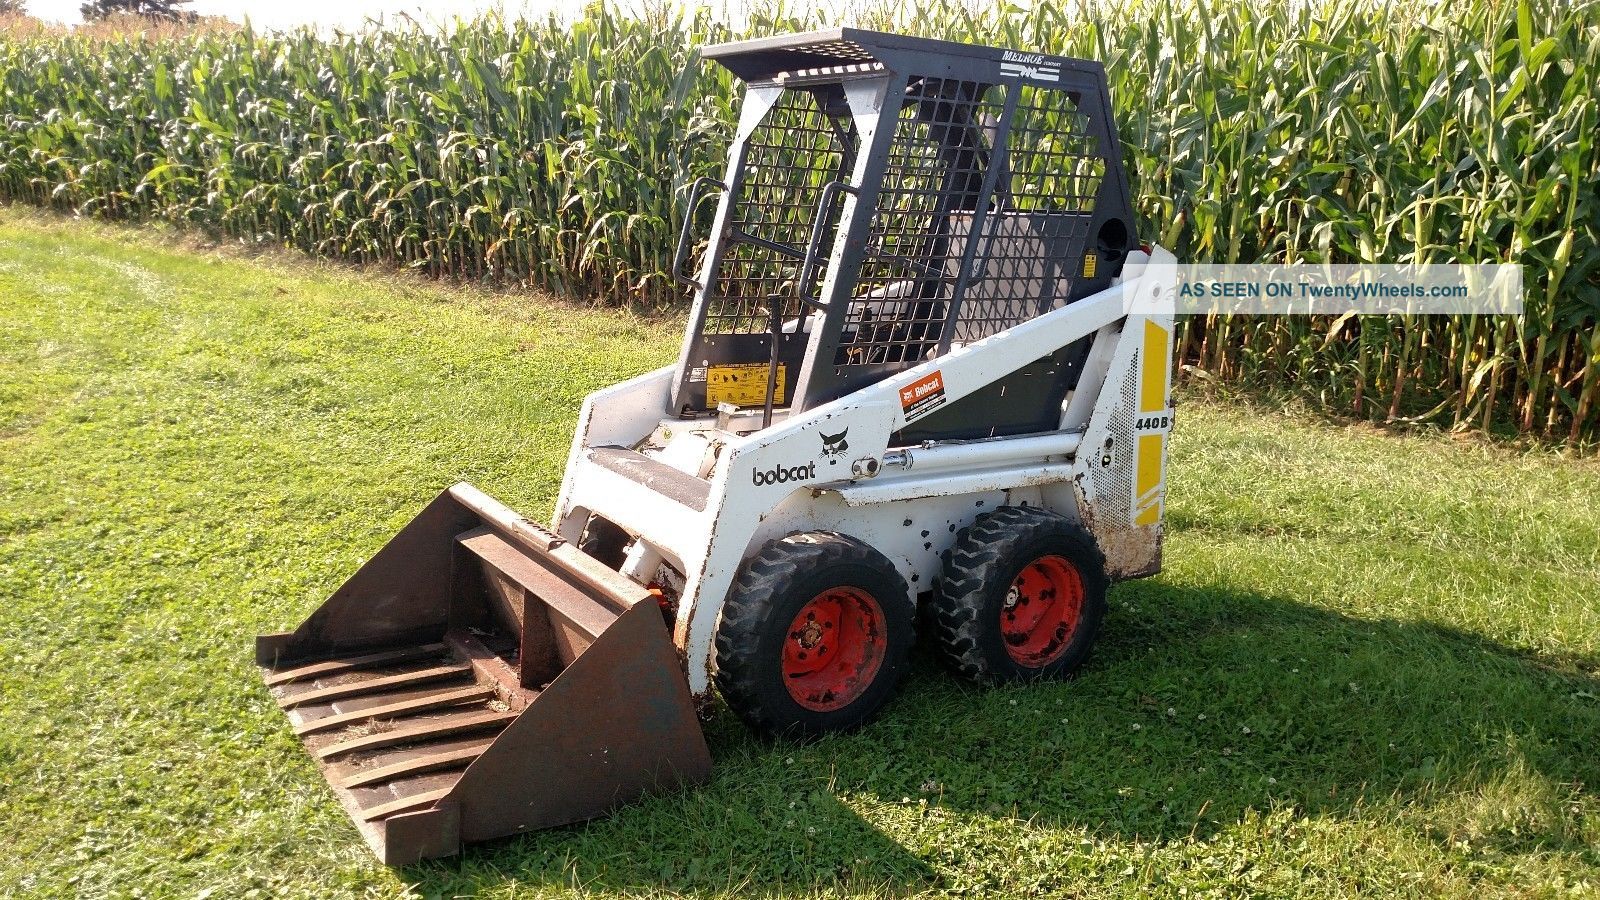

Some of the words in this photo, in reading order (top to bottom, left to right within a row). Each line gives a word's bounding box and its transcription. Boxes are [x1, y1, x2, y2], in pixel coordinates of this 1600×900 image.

[1001, 50, 1044, 65] MELROE
[914, 377, 939, 398] Bobcat
[752, 460, 816, 487] bobcat
